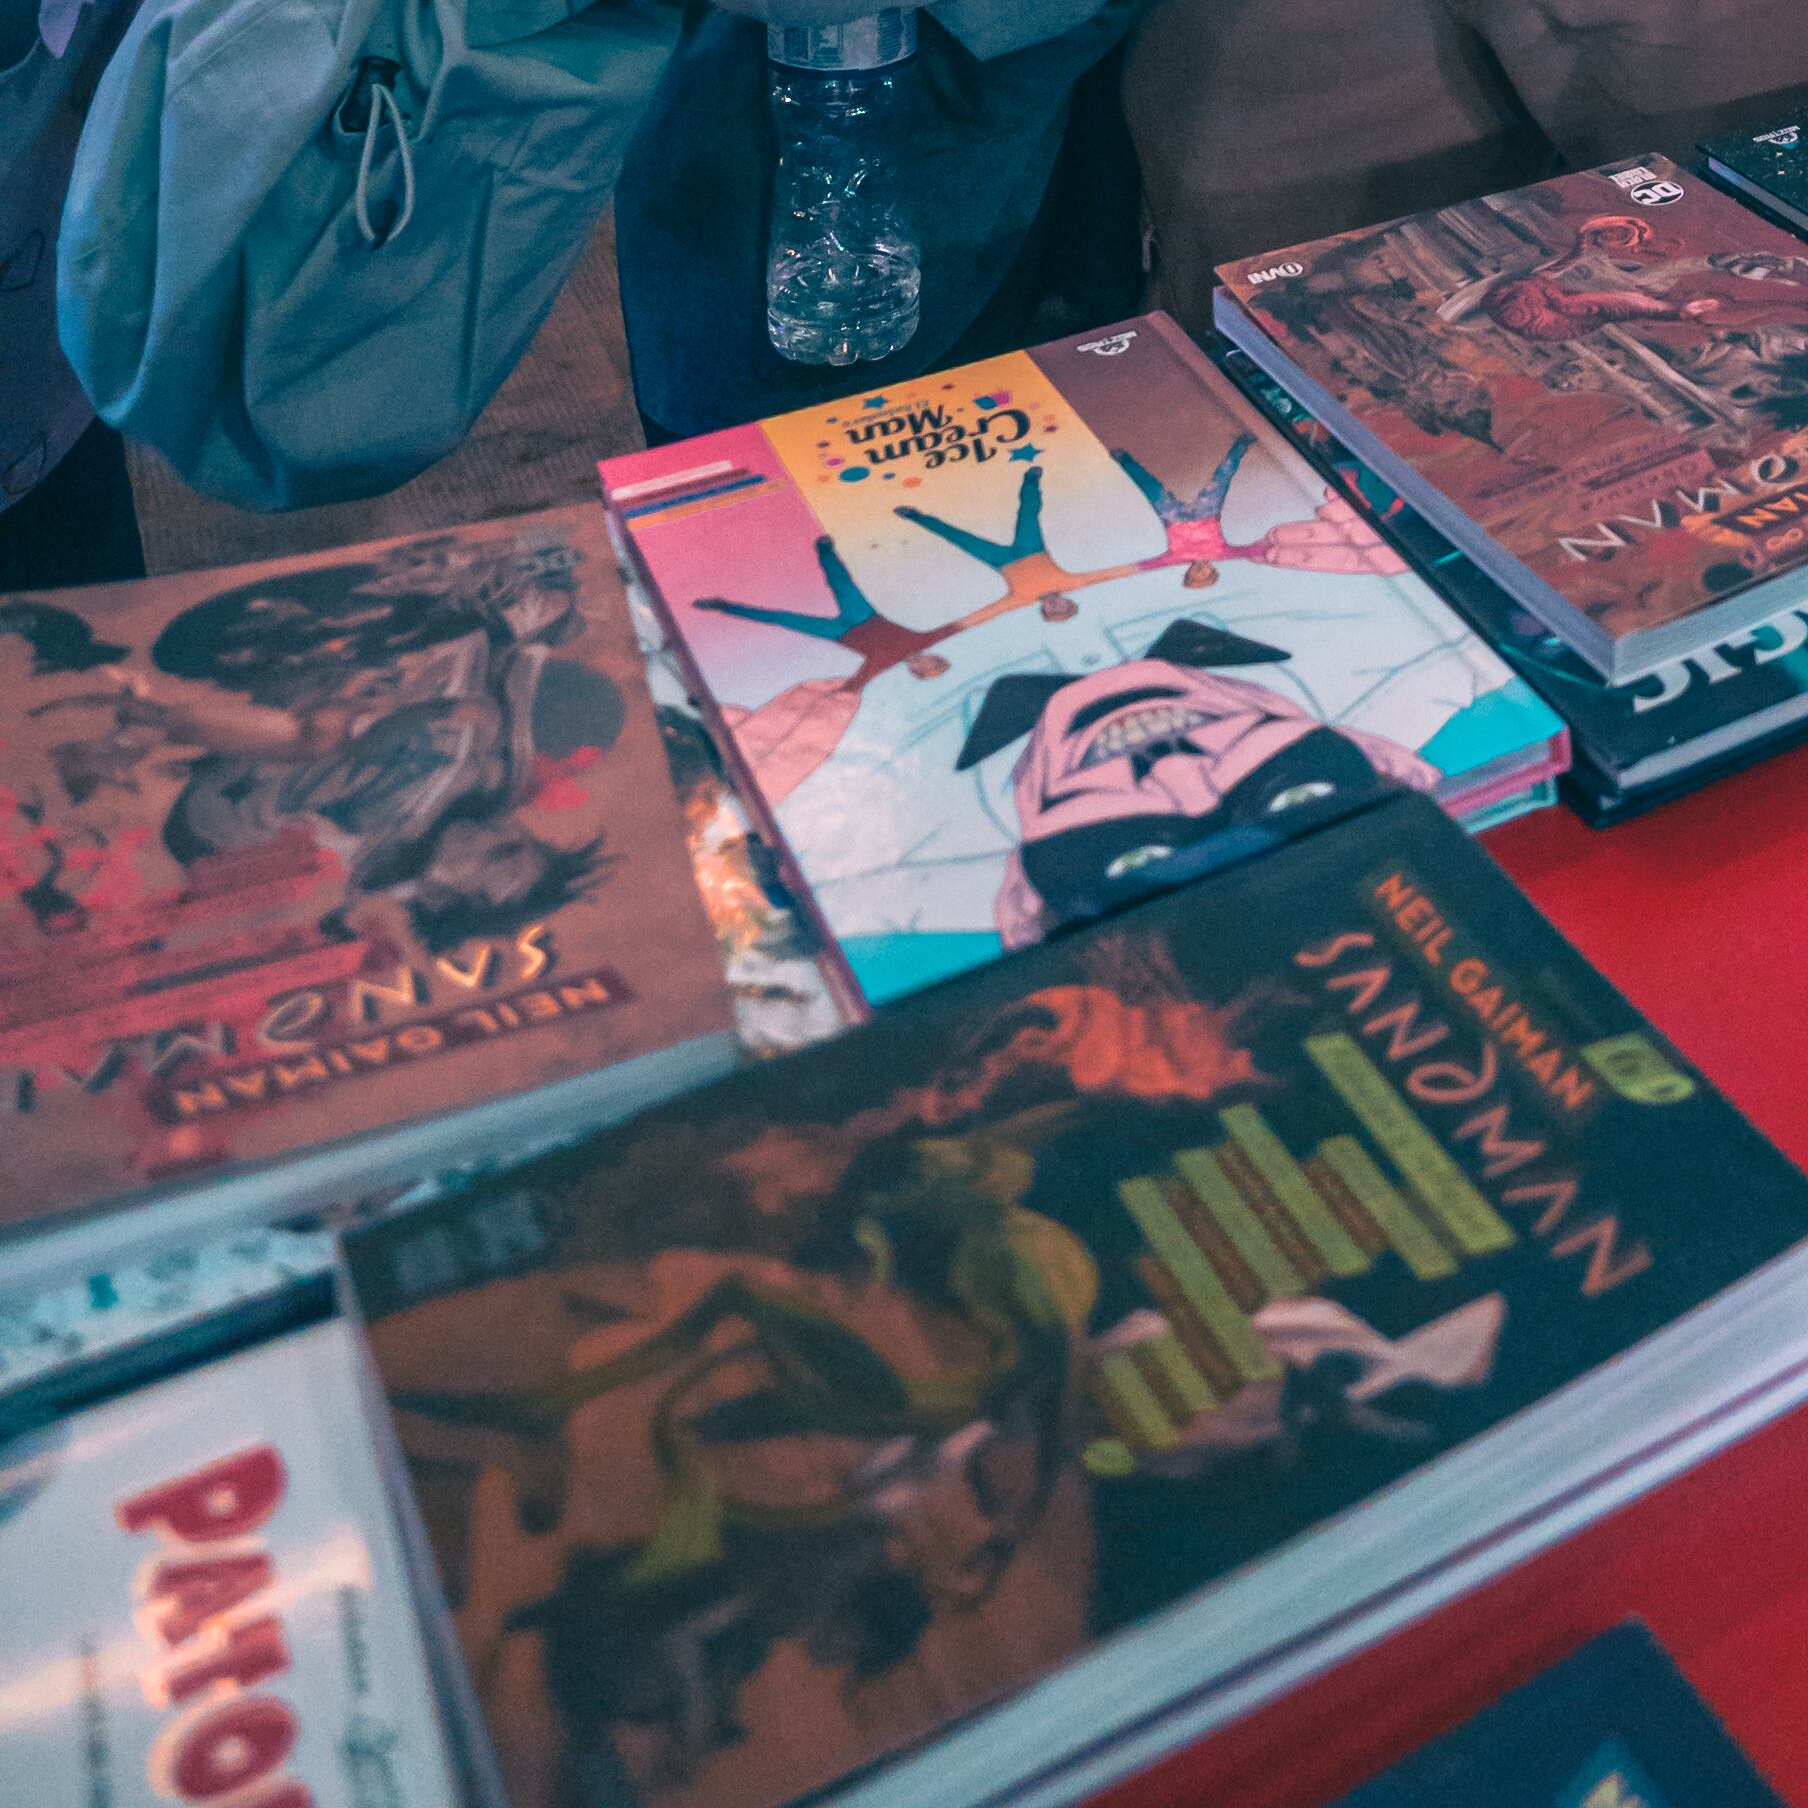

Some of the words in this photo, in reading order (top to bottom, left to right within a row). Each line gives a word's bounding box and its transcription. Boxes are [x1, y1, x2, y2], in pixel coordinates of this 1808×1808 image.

[1632, 182, 1683, 206] DC
[844, 404, 953, 446] Man
[864, 408, 1032, 466] Cream
[924, 436, 998, 470] Ice
[468, 977, 611, 1039] NEIL
[1373, 871, 1447, 967] NEIL
[1449, 955, 1598, 1112] GAIMAN
[172, 1026, 441, 1117] GAIMAN
[114, 1439, 318, 1808] PATO
